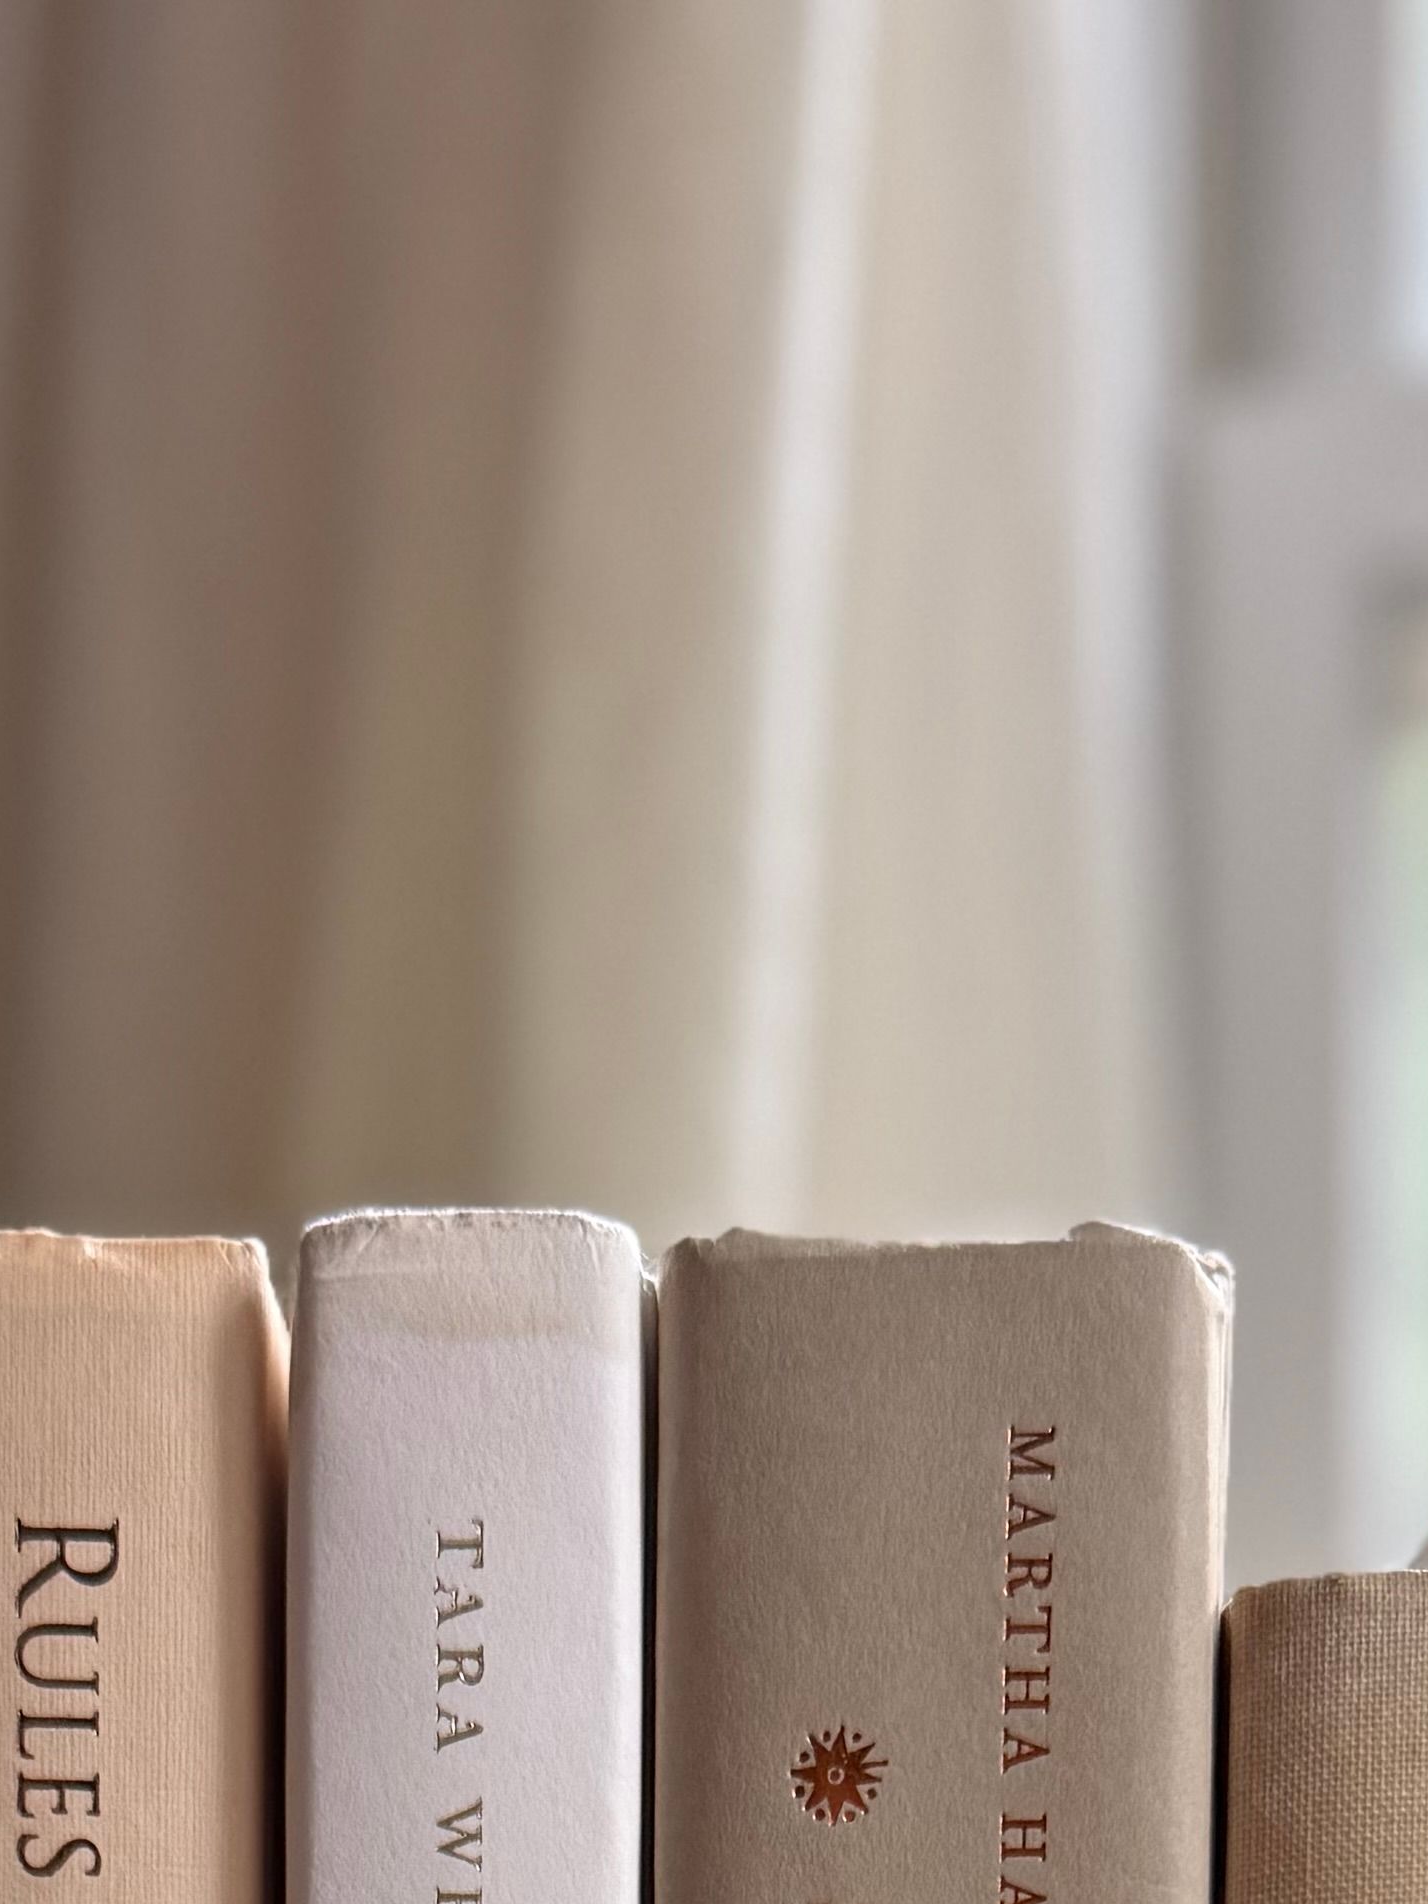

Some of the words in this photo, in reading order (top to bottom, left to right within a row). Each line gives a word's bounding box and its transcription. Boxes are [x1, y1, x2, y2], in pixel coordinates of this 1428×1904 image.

[12, 1515, 122, 1880] RULES
[432, 1515, 487, 1753] TARA
[999, 1423, 1057, 1776] MARTHA
